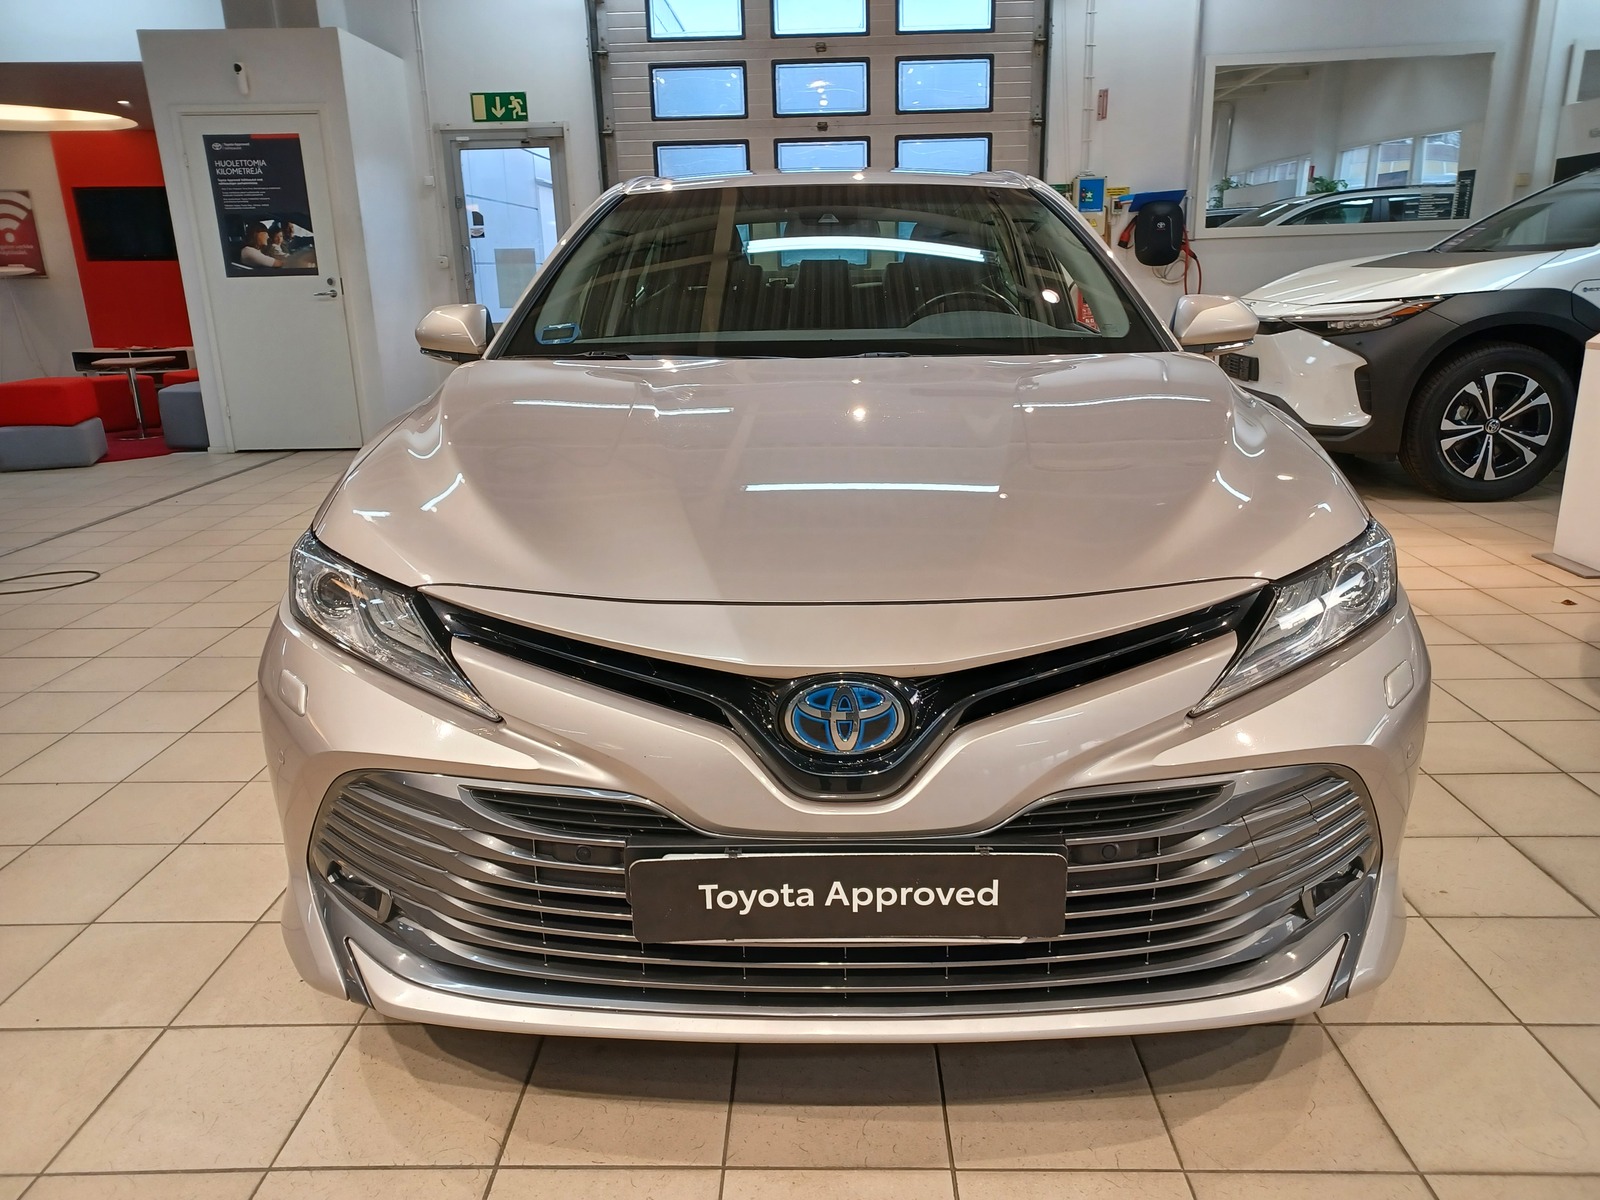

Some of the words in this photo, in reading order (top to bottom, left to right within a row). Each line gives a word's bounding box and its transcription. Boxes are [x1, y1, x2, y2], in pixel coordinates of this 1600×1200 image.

[214, 159, 267, 167] HUOLETTOMIA
[698, 883, 815, 915] Toyota
[824, 879, 999, 913] Approved
